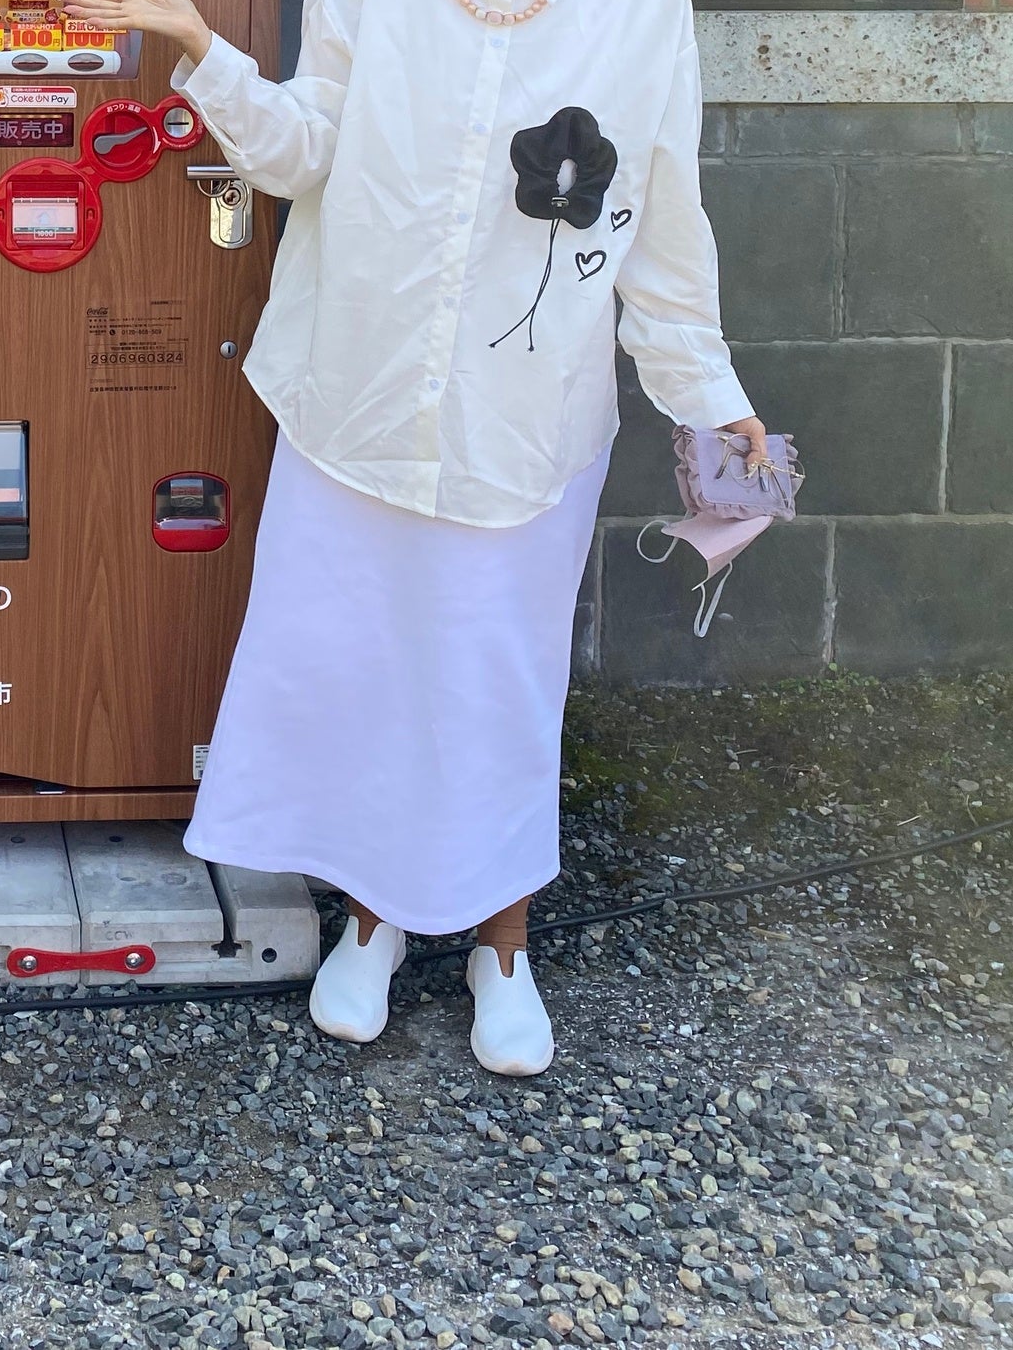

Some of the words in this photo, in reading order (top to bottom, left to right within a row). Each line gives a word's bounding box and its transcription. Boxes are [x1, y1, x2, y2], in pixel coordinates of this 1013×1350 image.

[12, 30, 61, 47] 100円
[11, 94, 34, 103] Coke
[35, 93, 50, 103] ON
[51, 94, 70, 105] Pay
[91, 353, 183, 365] 2906960324
